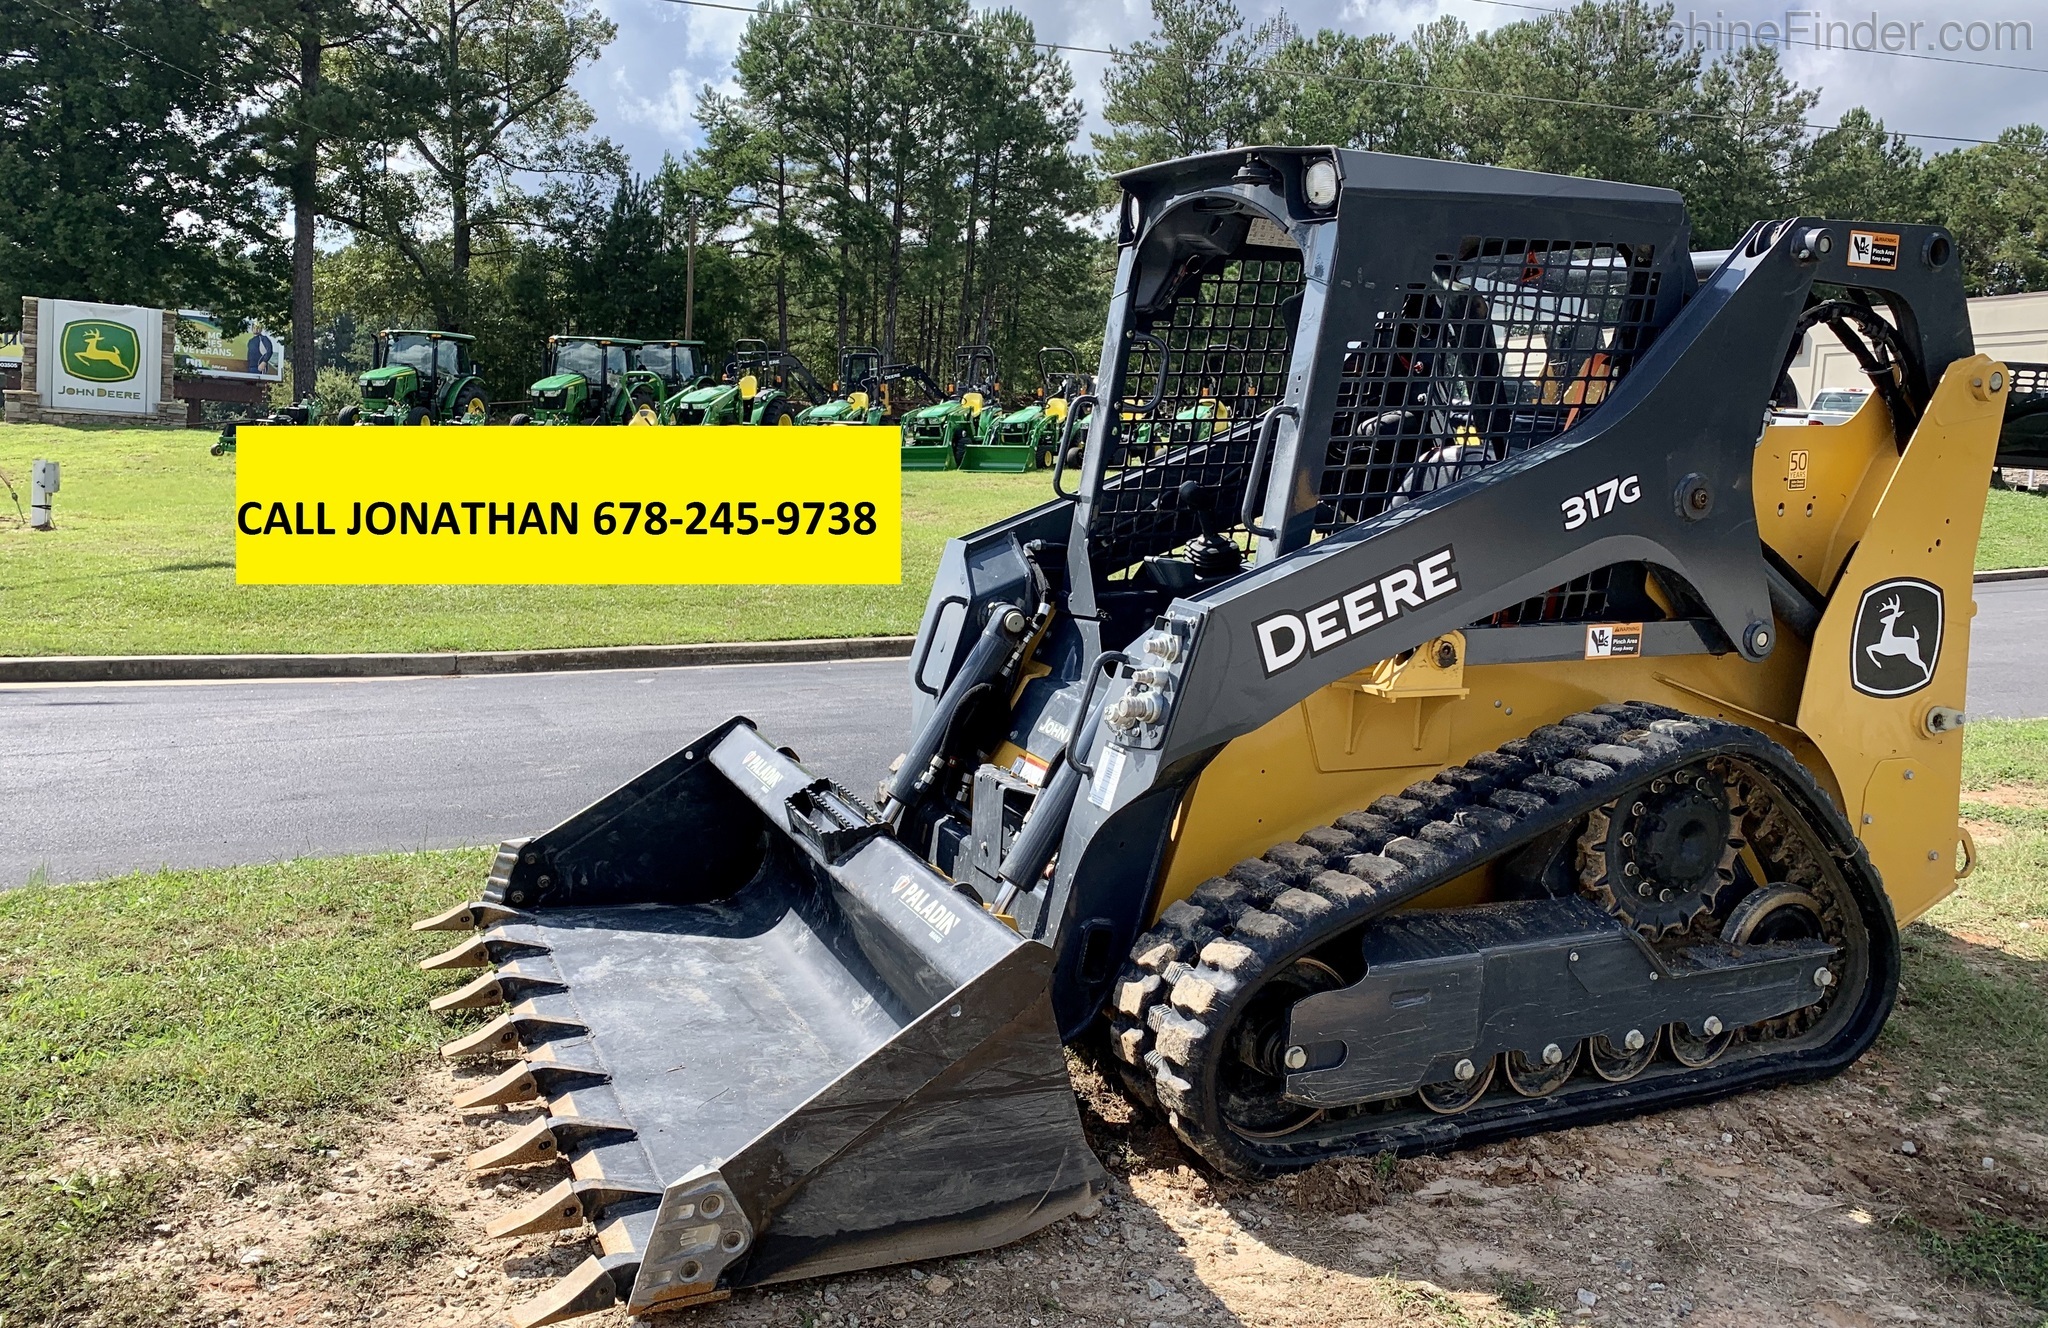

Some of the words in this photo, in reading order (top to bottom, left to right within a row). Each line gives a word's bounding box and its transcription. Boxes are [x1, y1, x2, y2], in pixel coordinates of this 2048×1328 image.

[58, 386, 95, 397] JOHN
[97, 388, 141, 400] DEERE
[1790, 452, 1807, 471] 50
[1561, 475, 1641, 530] 317G
[1256, 549, 1458, 673] DEERE
[1038, 716, 1068, 741] JOHN
[747, 755, 784, 788] PALADIN
[900, 882, 961, 936] PALADIN
